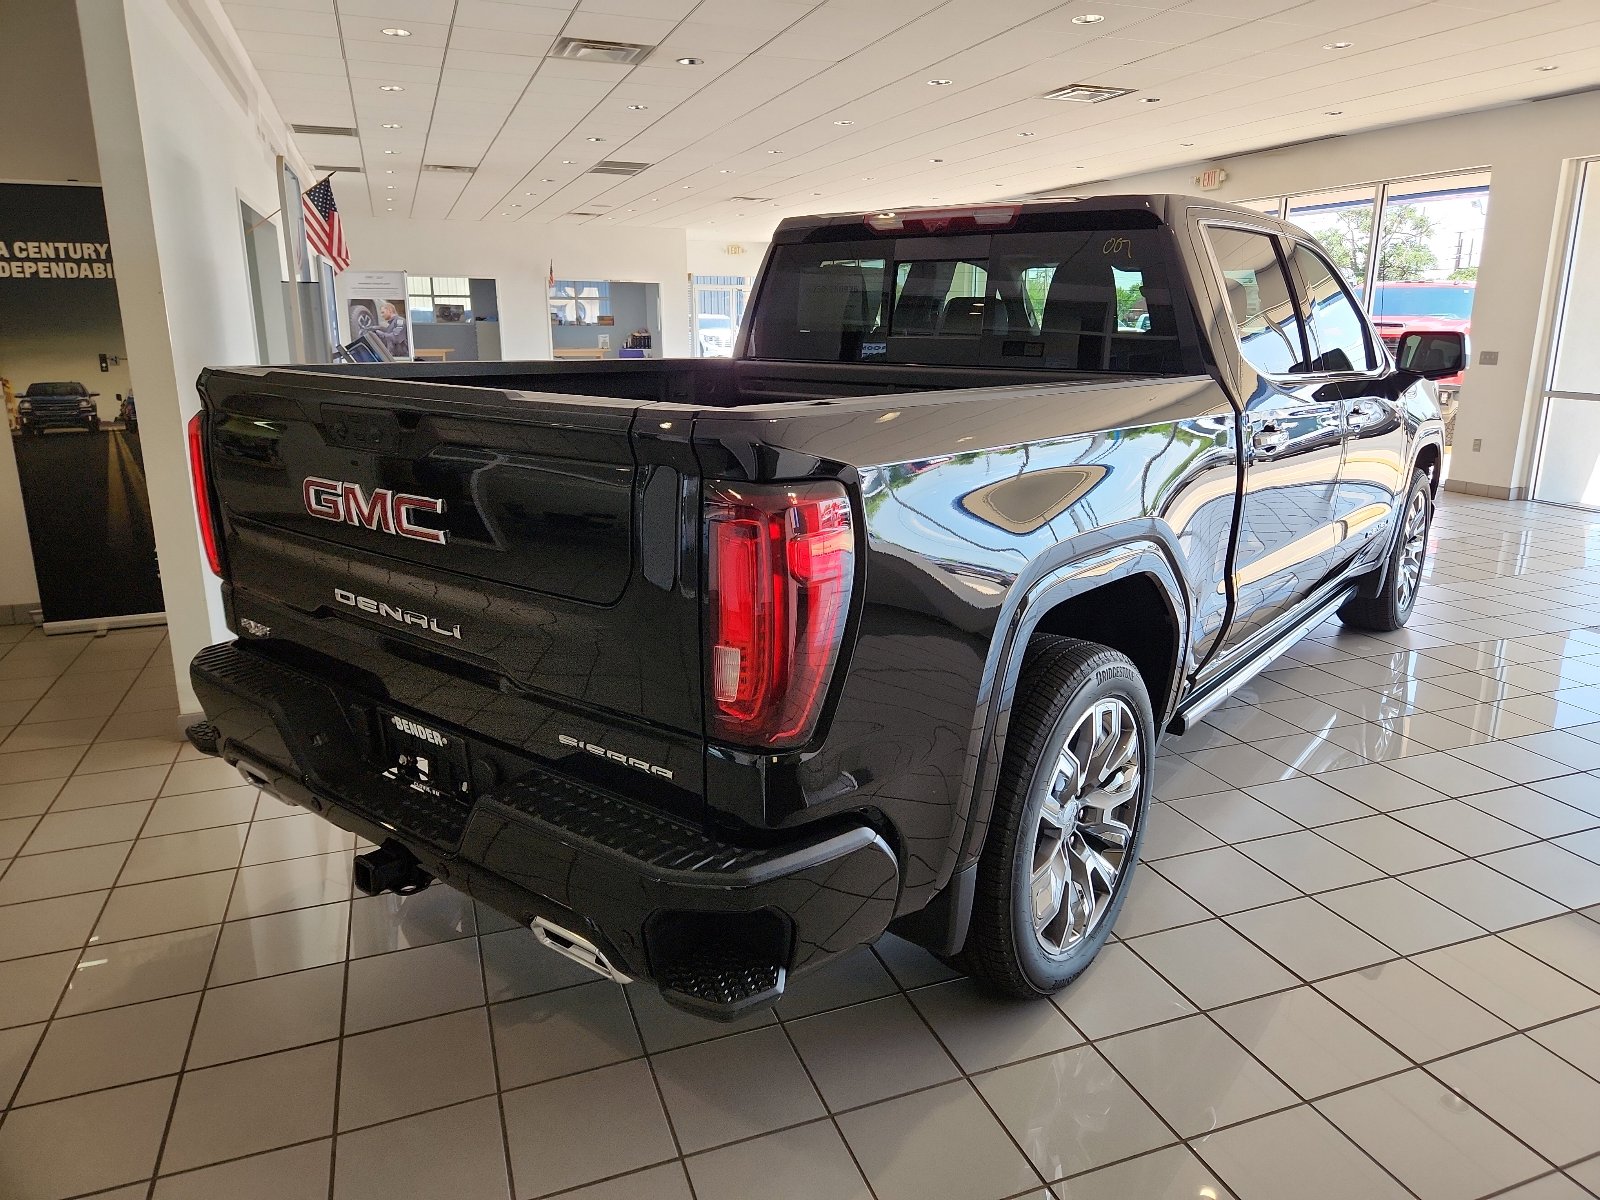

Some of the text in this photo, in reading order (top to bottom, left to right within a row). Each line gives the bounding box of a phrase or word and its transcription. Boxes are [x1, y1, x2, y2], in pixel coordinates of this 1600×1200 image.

[1202, 170, 1218, 188] EXIT
[0, 241, 109, 260] A CENTURY
[303, 476, 448, 545] GMC
[334, 588, 461, 639] DENALI
[393, 715, 444, 747] BENDER
[558, 734, 673, 780] SIERRA
